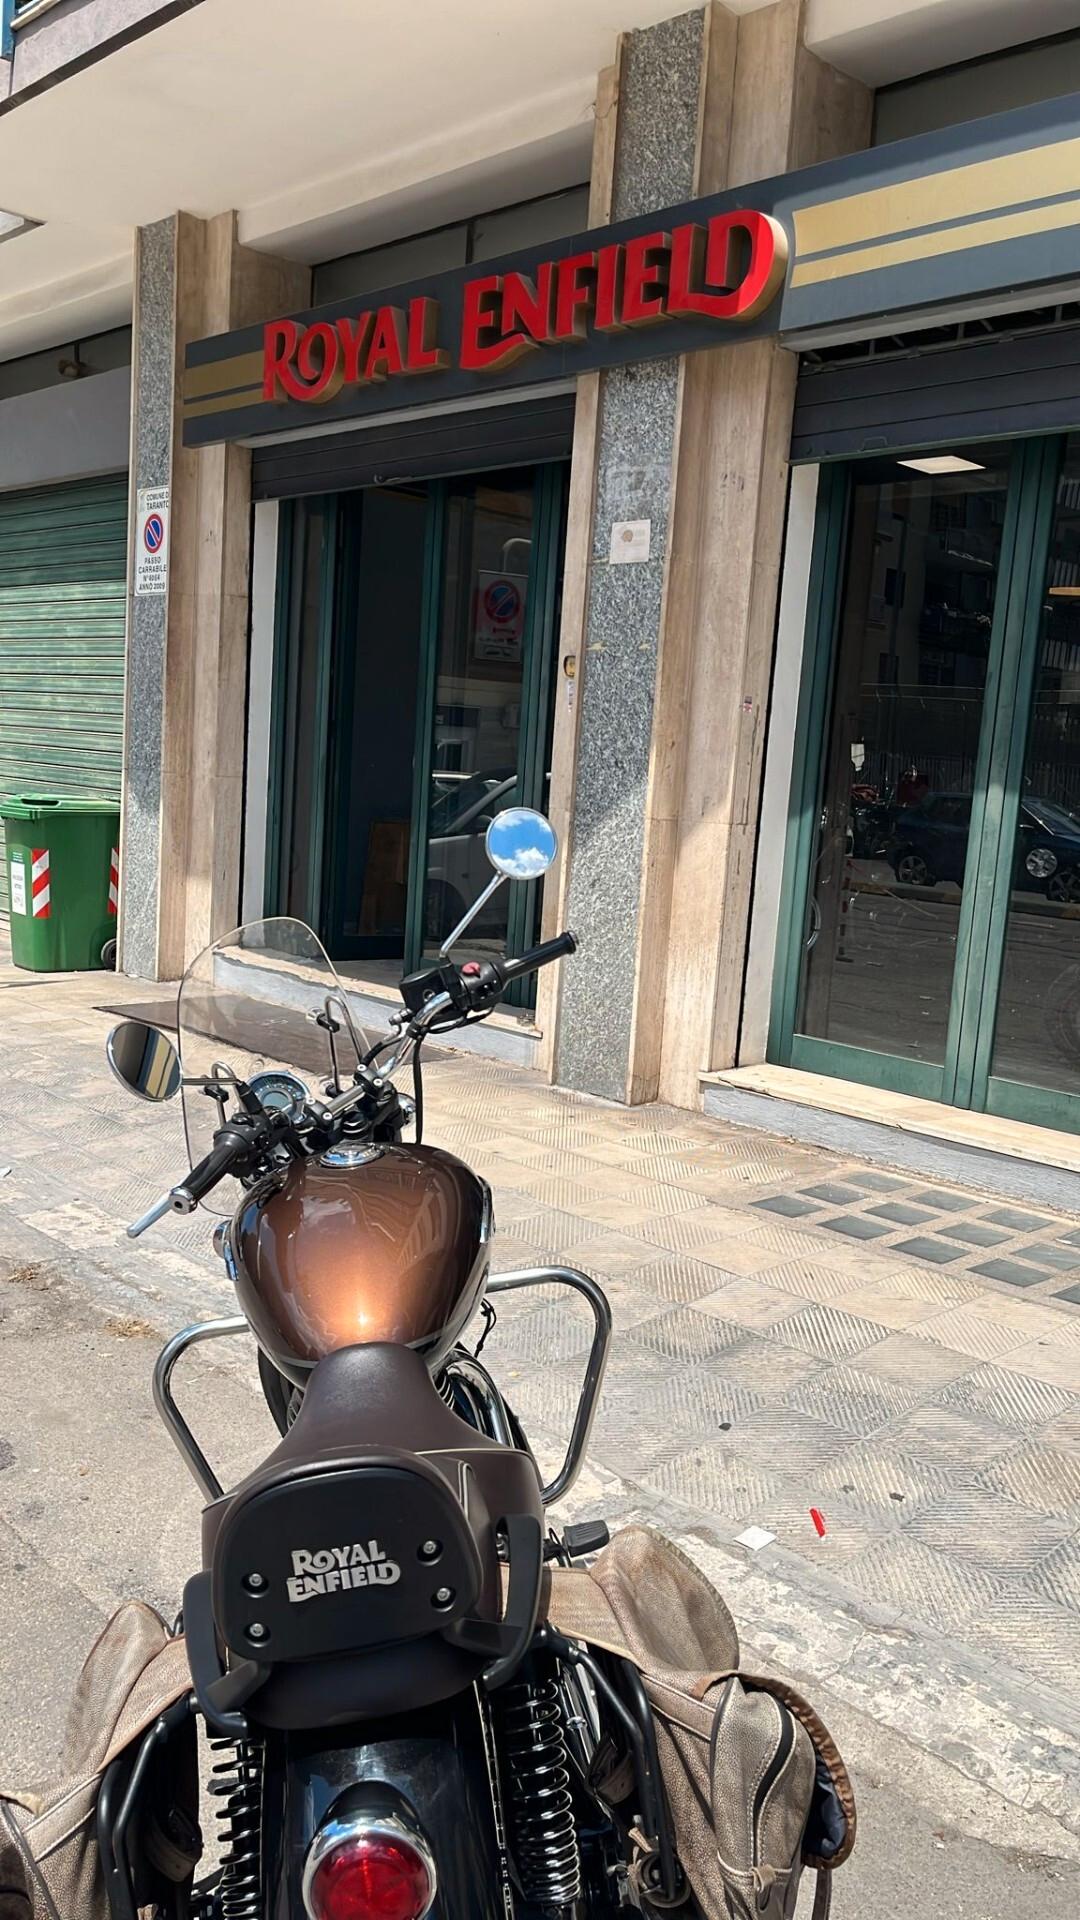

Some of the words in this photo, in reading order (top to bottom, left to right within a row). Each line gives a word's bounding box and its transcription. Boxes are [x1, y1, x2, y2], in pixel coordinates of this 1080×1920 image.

[262, 297, 445, 403] ROYAL
[459, 208, 783, 372] ENFIELD
[138, 564, 167, 574] CARRABILE
[144, 556, 161, 564] PASSO
[291, 1540, 386, 1576] ROYAL
[286, 1560, 401, 1602] ENFIELD
